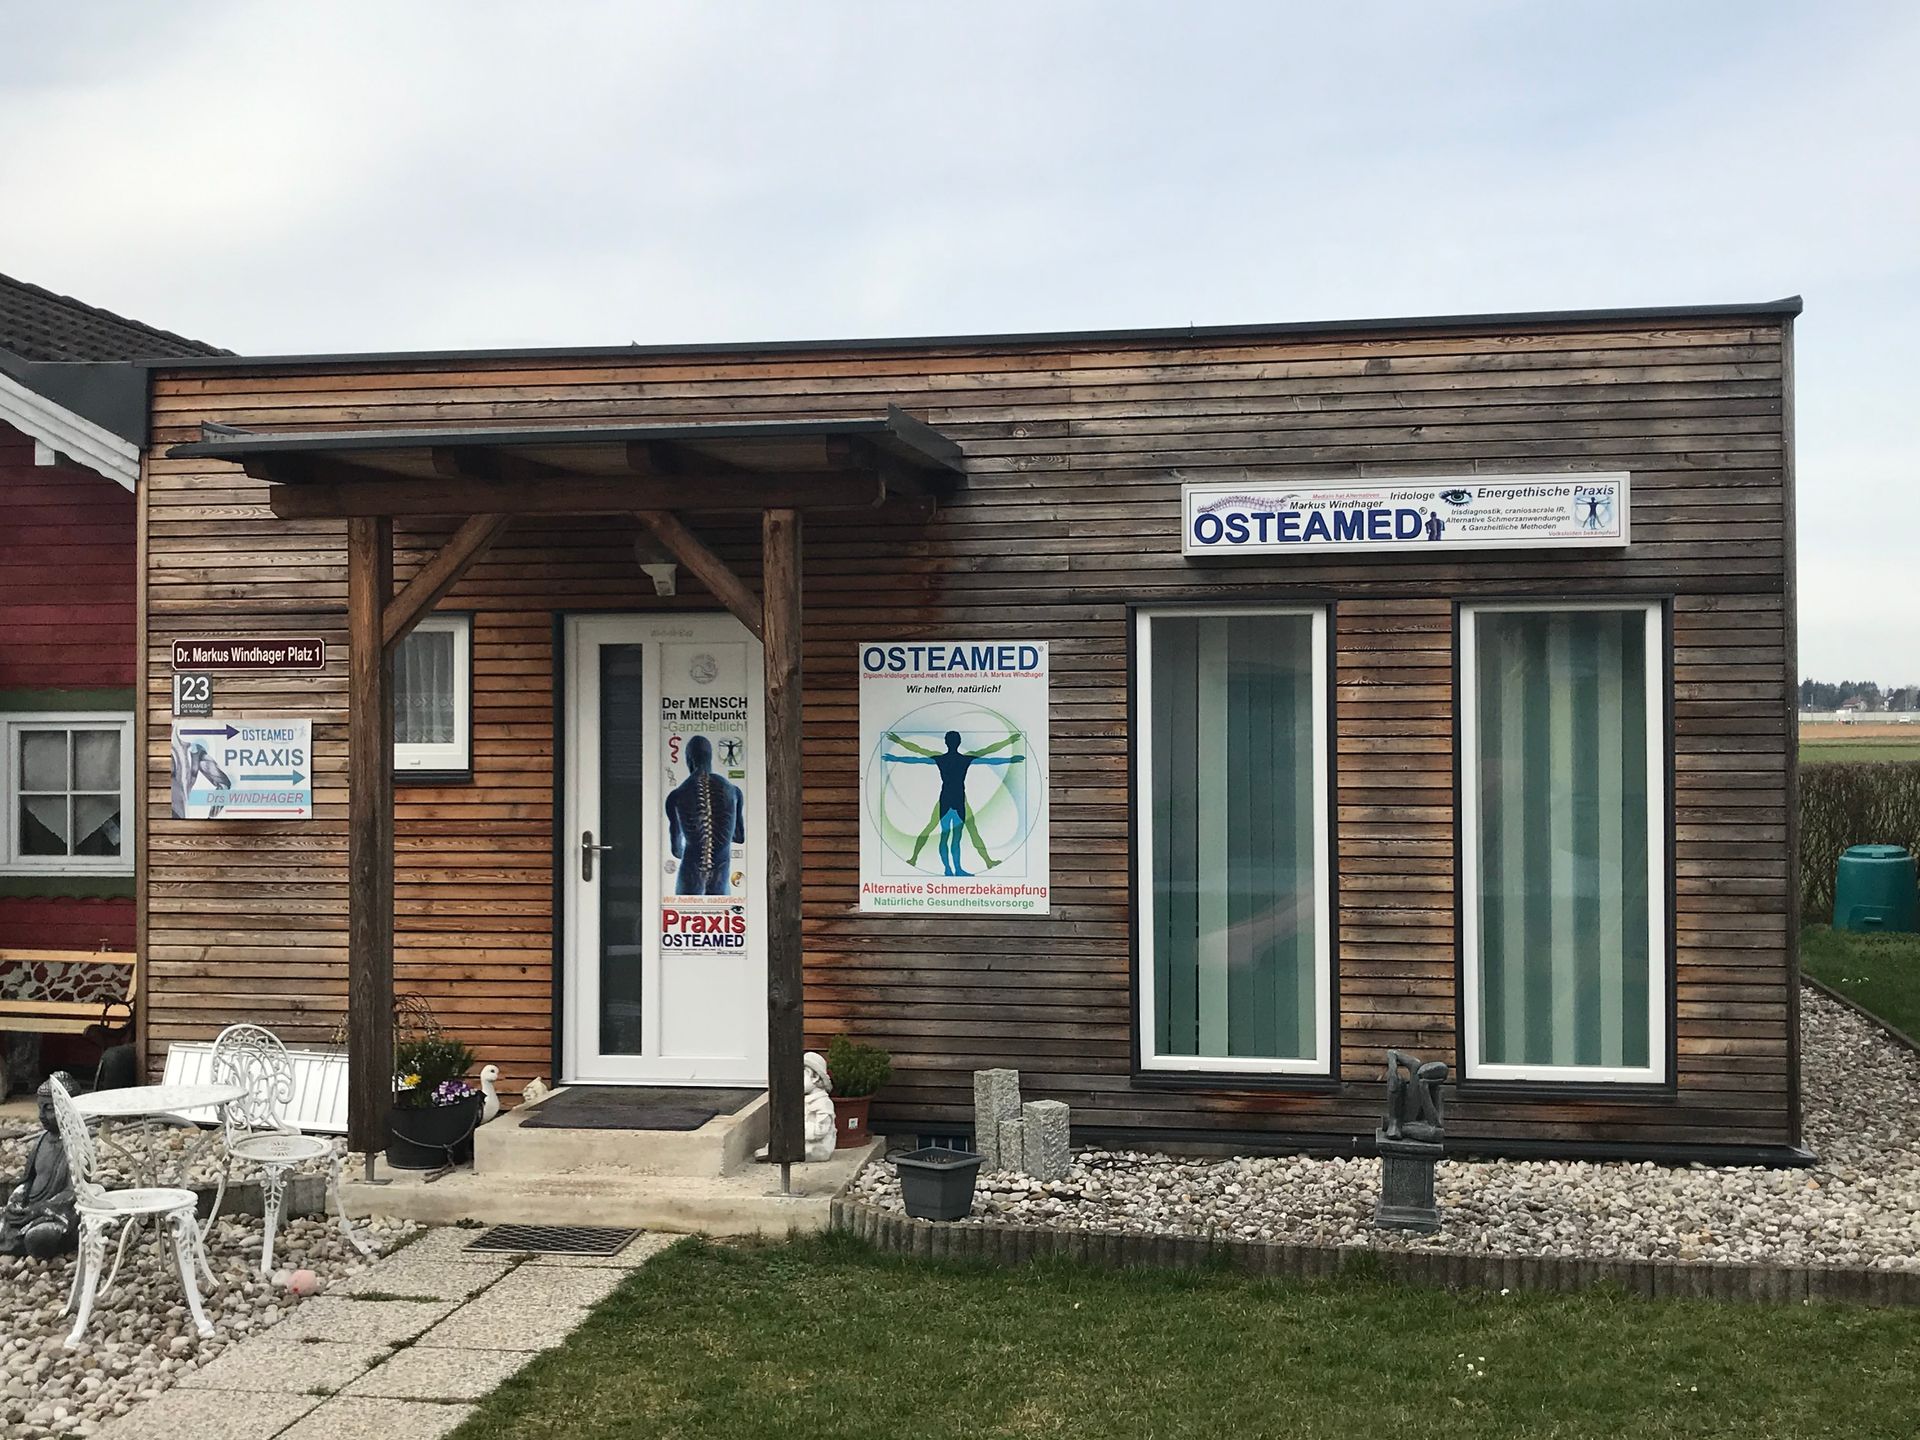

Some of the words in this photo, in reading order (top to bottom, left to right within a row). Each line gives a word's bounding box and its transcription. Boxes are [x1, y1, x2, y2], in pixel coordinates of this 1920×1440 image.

[1390, 491, 1435, 502] Iridologe
[1477, 486, 1570, 499] Energethische
[1573, 485, 1615, 496] Praxis
[1289, 501, 1326, 510] Markus
[1329, 499, 1384, 510] Windhager
[1451, 508, 1503, 516] Irisdiagnostik,
[1487, 515, 1570, 523] Schmerzanwendungen
[1194, 508, 1423, 544] OSTEAMED
[176, 647, 190, 662] Dr.
[193, 647, 229, 662] Markus
[231, 647, 286, 664] Windhager
[288, 646, 313, 661] Platz
[314, 646, 320, 661] 1
[863, 646, 1039, 671] OSTEAMED
[1013, 671, 1044, 679] Windhager
[182, 676, 210, 701] 23
[906, 685, 922, 694] Wir
[924, 685, 955, 695] helfen,
[957, 685, 1002, 694] natürlich!
[662, 697, 685, 709] Der
[688, 697, 748, 709] MENSCH
[662, 710, 677, 721] im
[680, 710, 747, 722] Mittelpunkt
[242, 728, 294, 741] OSTEAMED
[225, 748, 304, 766] PRAXIS
[207, 793, 225, 803] Drs
[229, 792, 304, 803] WINDHAGER
[862, 883, 923, 894] Alternative
[926, 883, 1047, 898] Schmerzbekämpfung
[874, 897, 924, 907] Natürliche
[927, 897, 1034, 910] Gesundheitsvorsorge
[662, 909, 746, 934] Praxis
[662, 934, 744, 947] OSTEAMED
